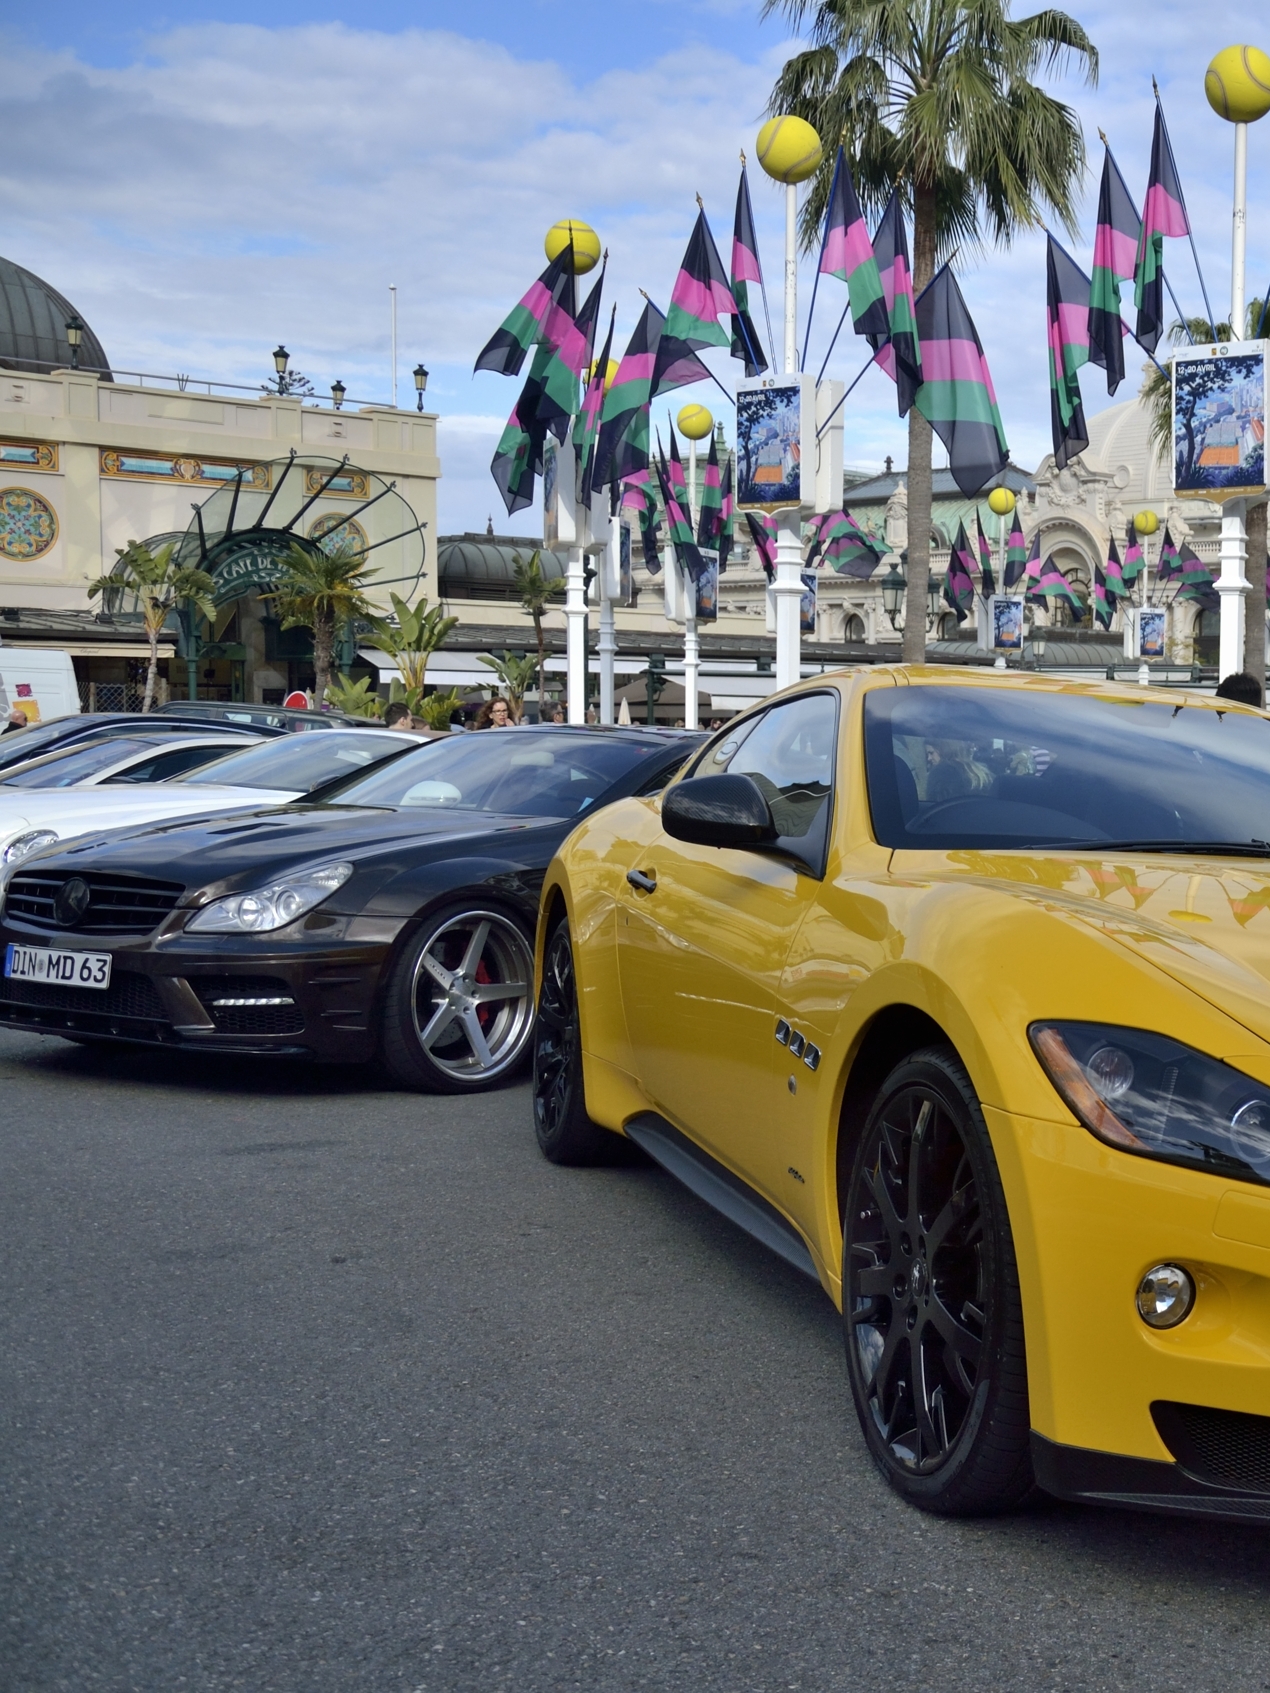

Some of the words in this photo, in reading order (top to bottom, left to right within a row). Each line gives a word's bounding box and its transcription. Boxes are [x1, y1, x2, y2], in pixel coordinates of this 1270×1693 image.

[1196, 363, 1216, 372] AVRIL
[257, 555, 275, 569] DE
[12, 949, 37, 977] DIN
[46, 953, 75, 981] MD
[79, 957, 108, 984] 63
